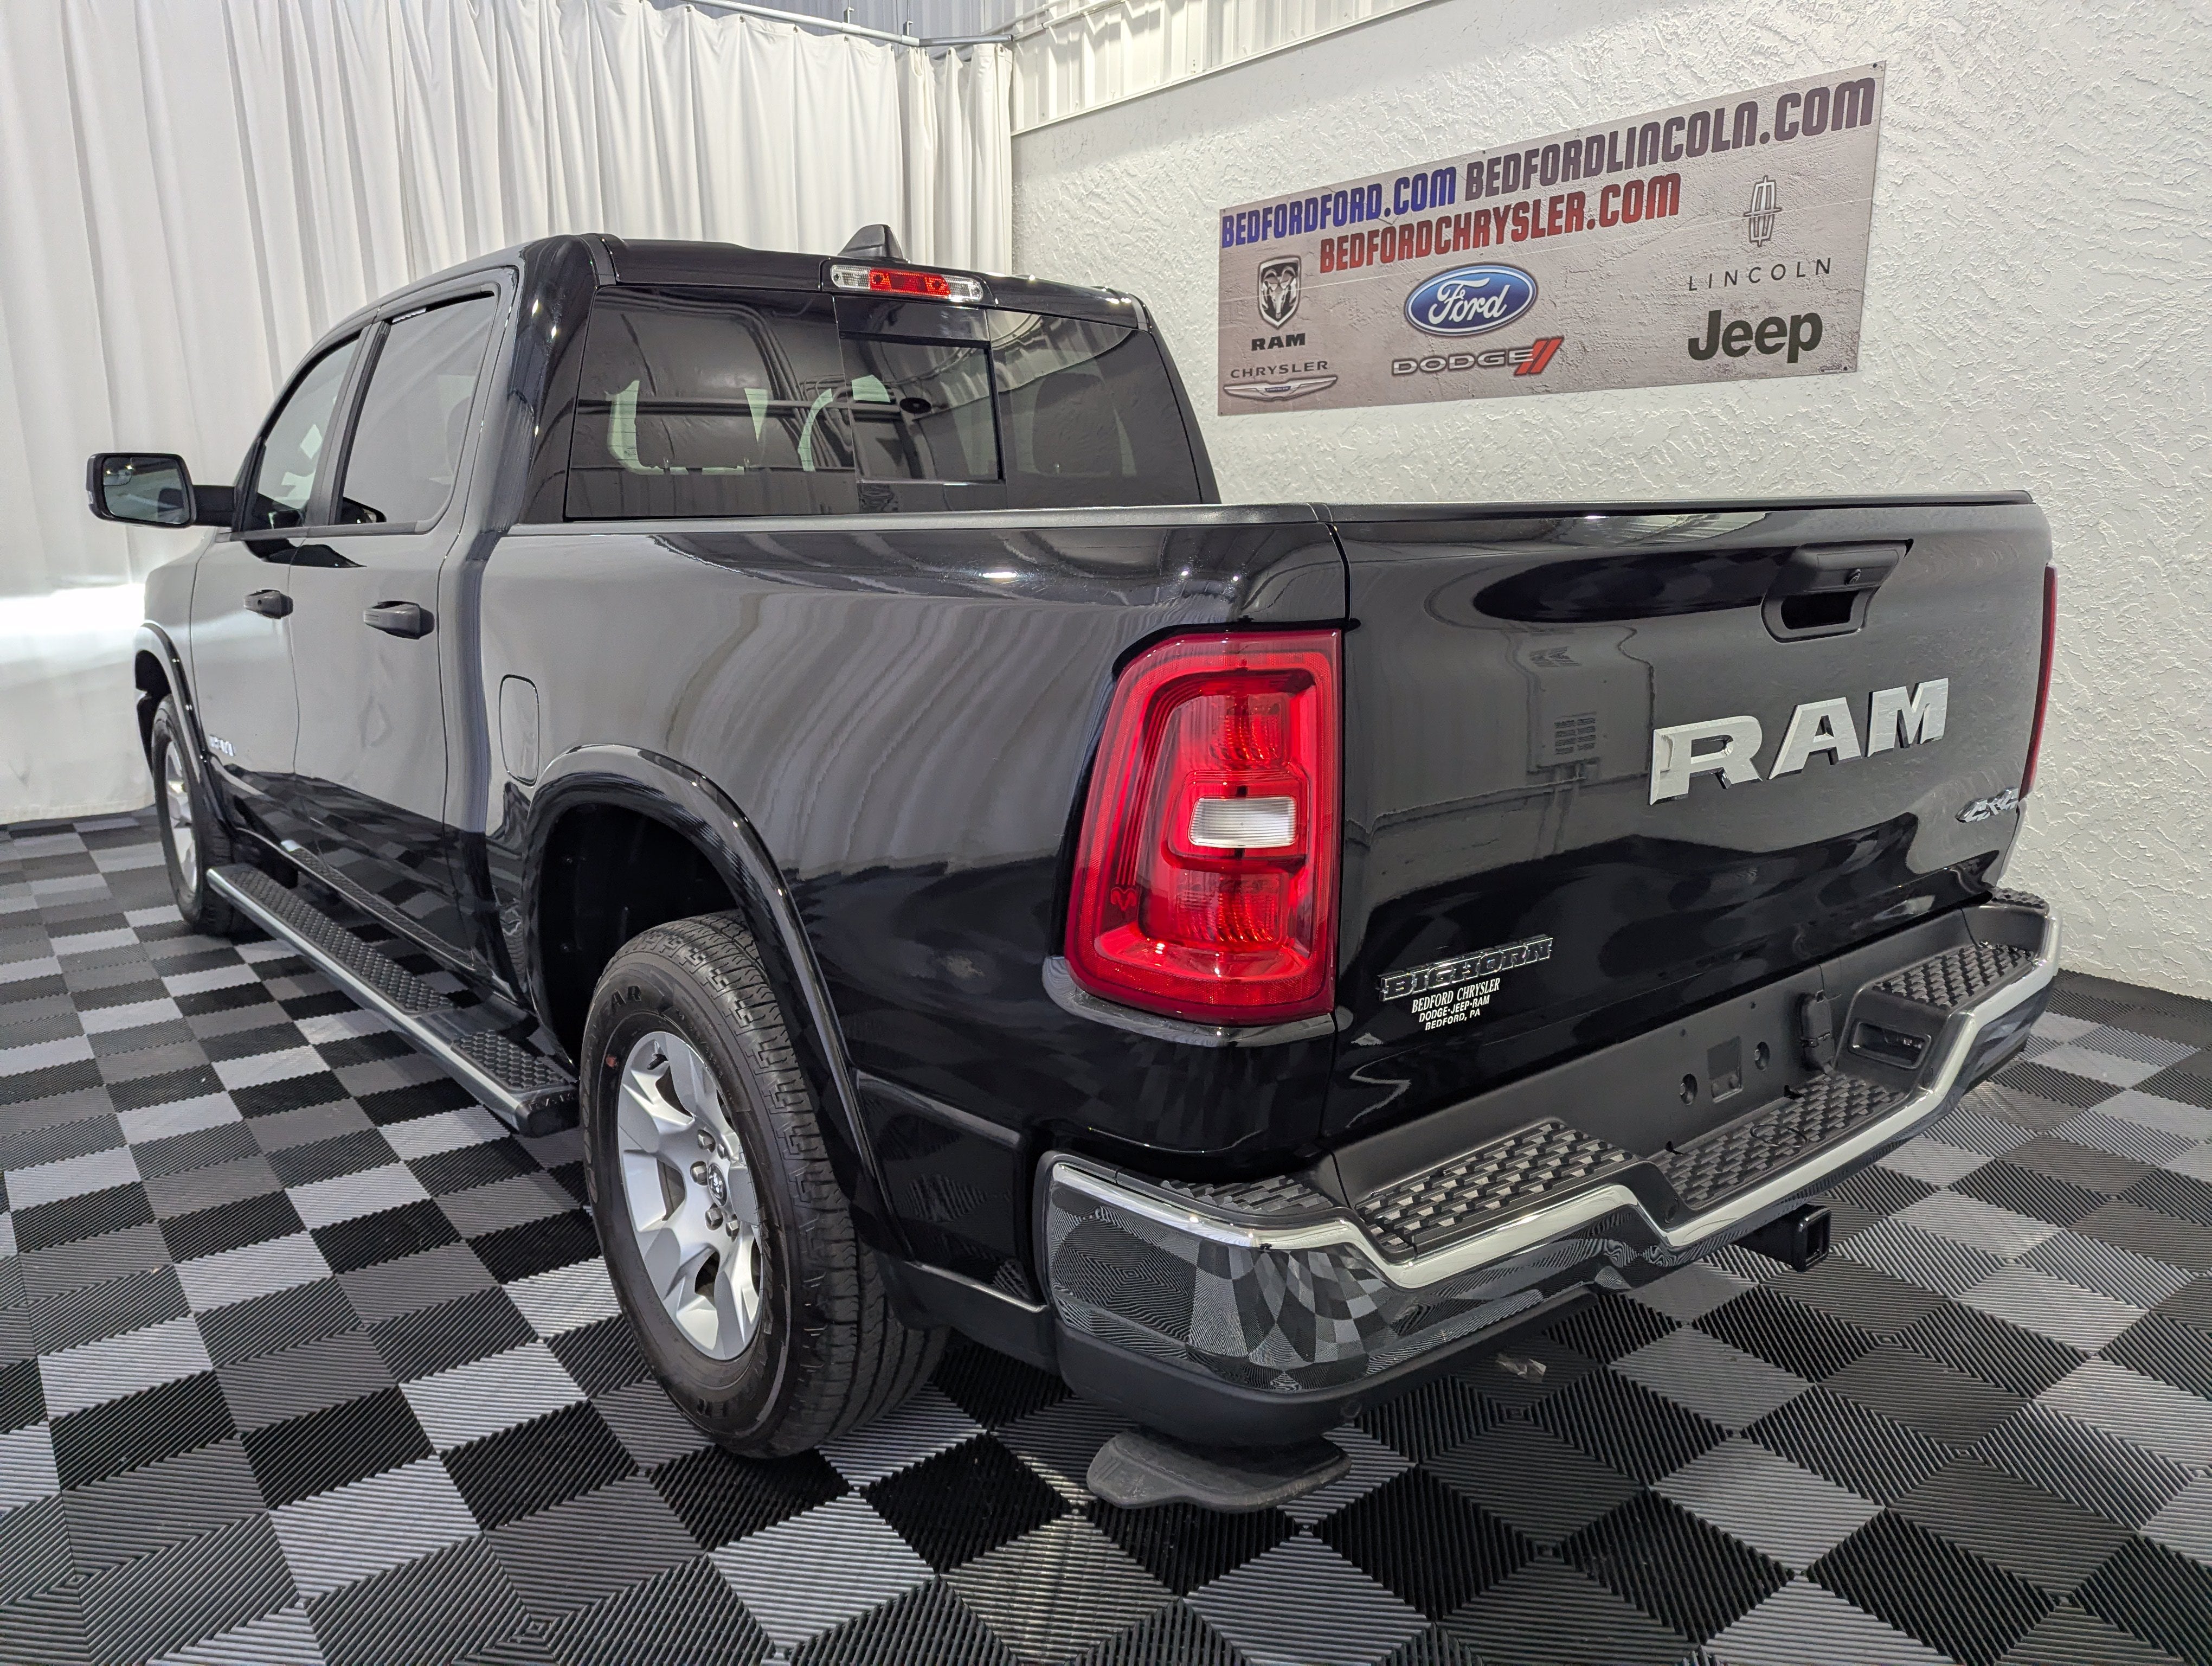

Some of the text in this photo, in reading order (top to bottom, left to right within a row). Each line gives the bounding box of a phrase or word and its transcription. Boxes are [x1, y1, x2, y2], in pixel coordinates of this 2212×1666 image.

[1221, 77, 1876, 249] BEDFORDFORD.COM BEDFORDLINCOLN.COM
[1319, 172, 1681, 274] BEDFORDCHRYSLER.COM
[1688, 257, 1831, 291] LINCOLN
[1427, 277, 1511, 325] Ford
[1251, 332, 1306, 351] RAM
[1687, 309, 1823, 364] Jeep
[1230, 360, 1328, 379] CHRYSLER
[1392, 348, 1535, 375] DODGE
[1649, 677, 1949, 805] RAM
[1411, 977, 1501, 1014] BEDFORD CHRYSLER
[1425, 1008, 1481, 1031] BEDFORD, PA
